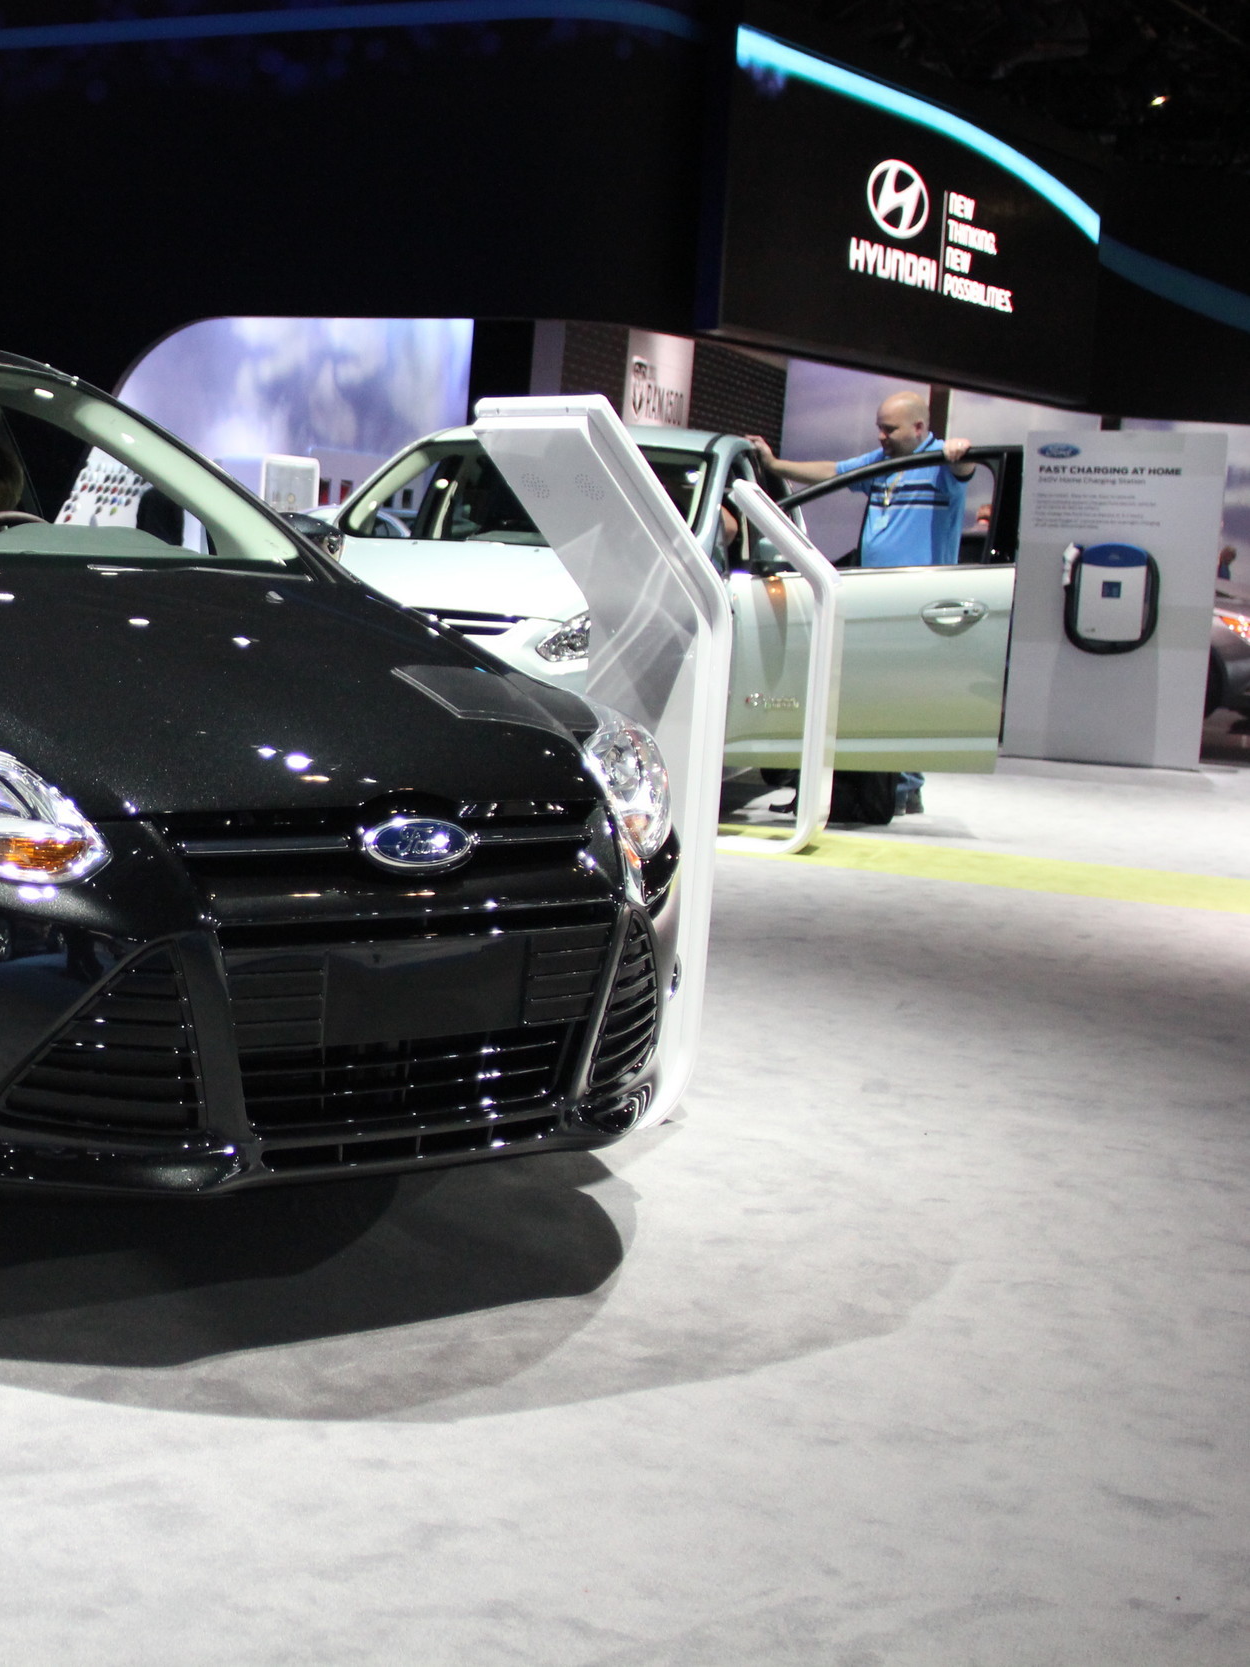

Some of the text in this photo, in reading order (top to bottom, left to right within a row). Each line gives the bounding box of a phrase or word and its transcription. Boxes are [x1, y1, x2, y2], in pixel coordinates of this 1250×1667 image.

[949, 191, 976, 221] NEW
[849, 236, 938, 292] HYUNDAI
[945, 246, 972, 274] NEW
[1039, 466, 1182, 477] FAST CHARGING AT HOME
